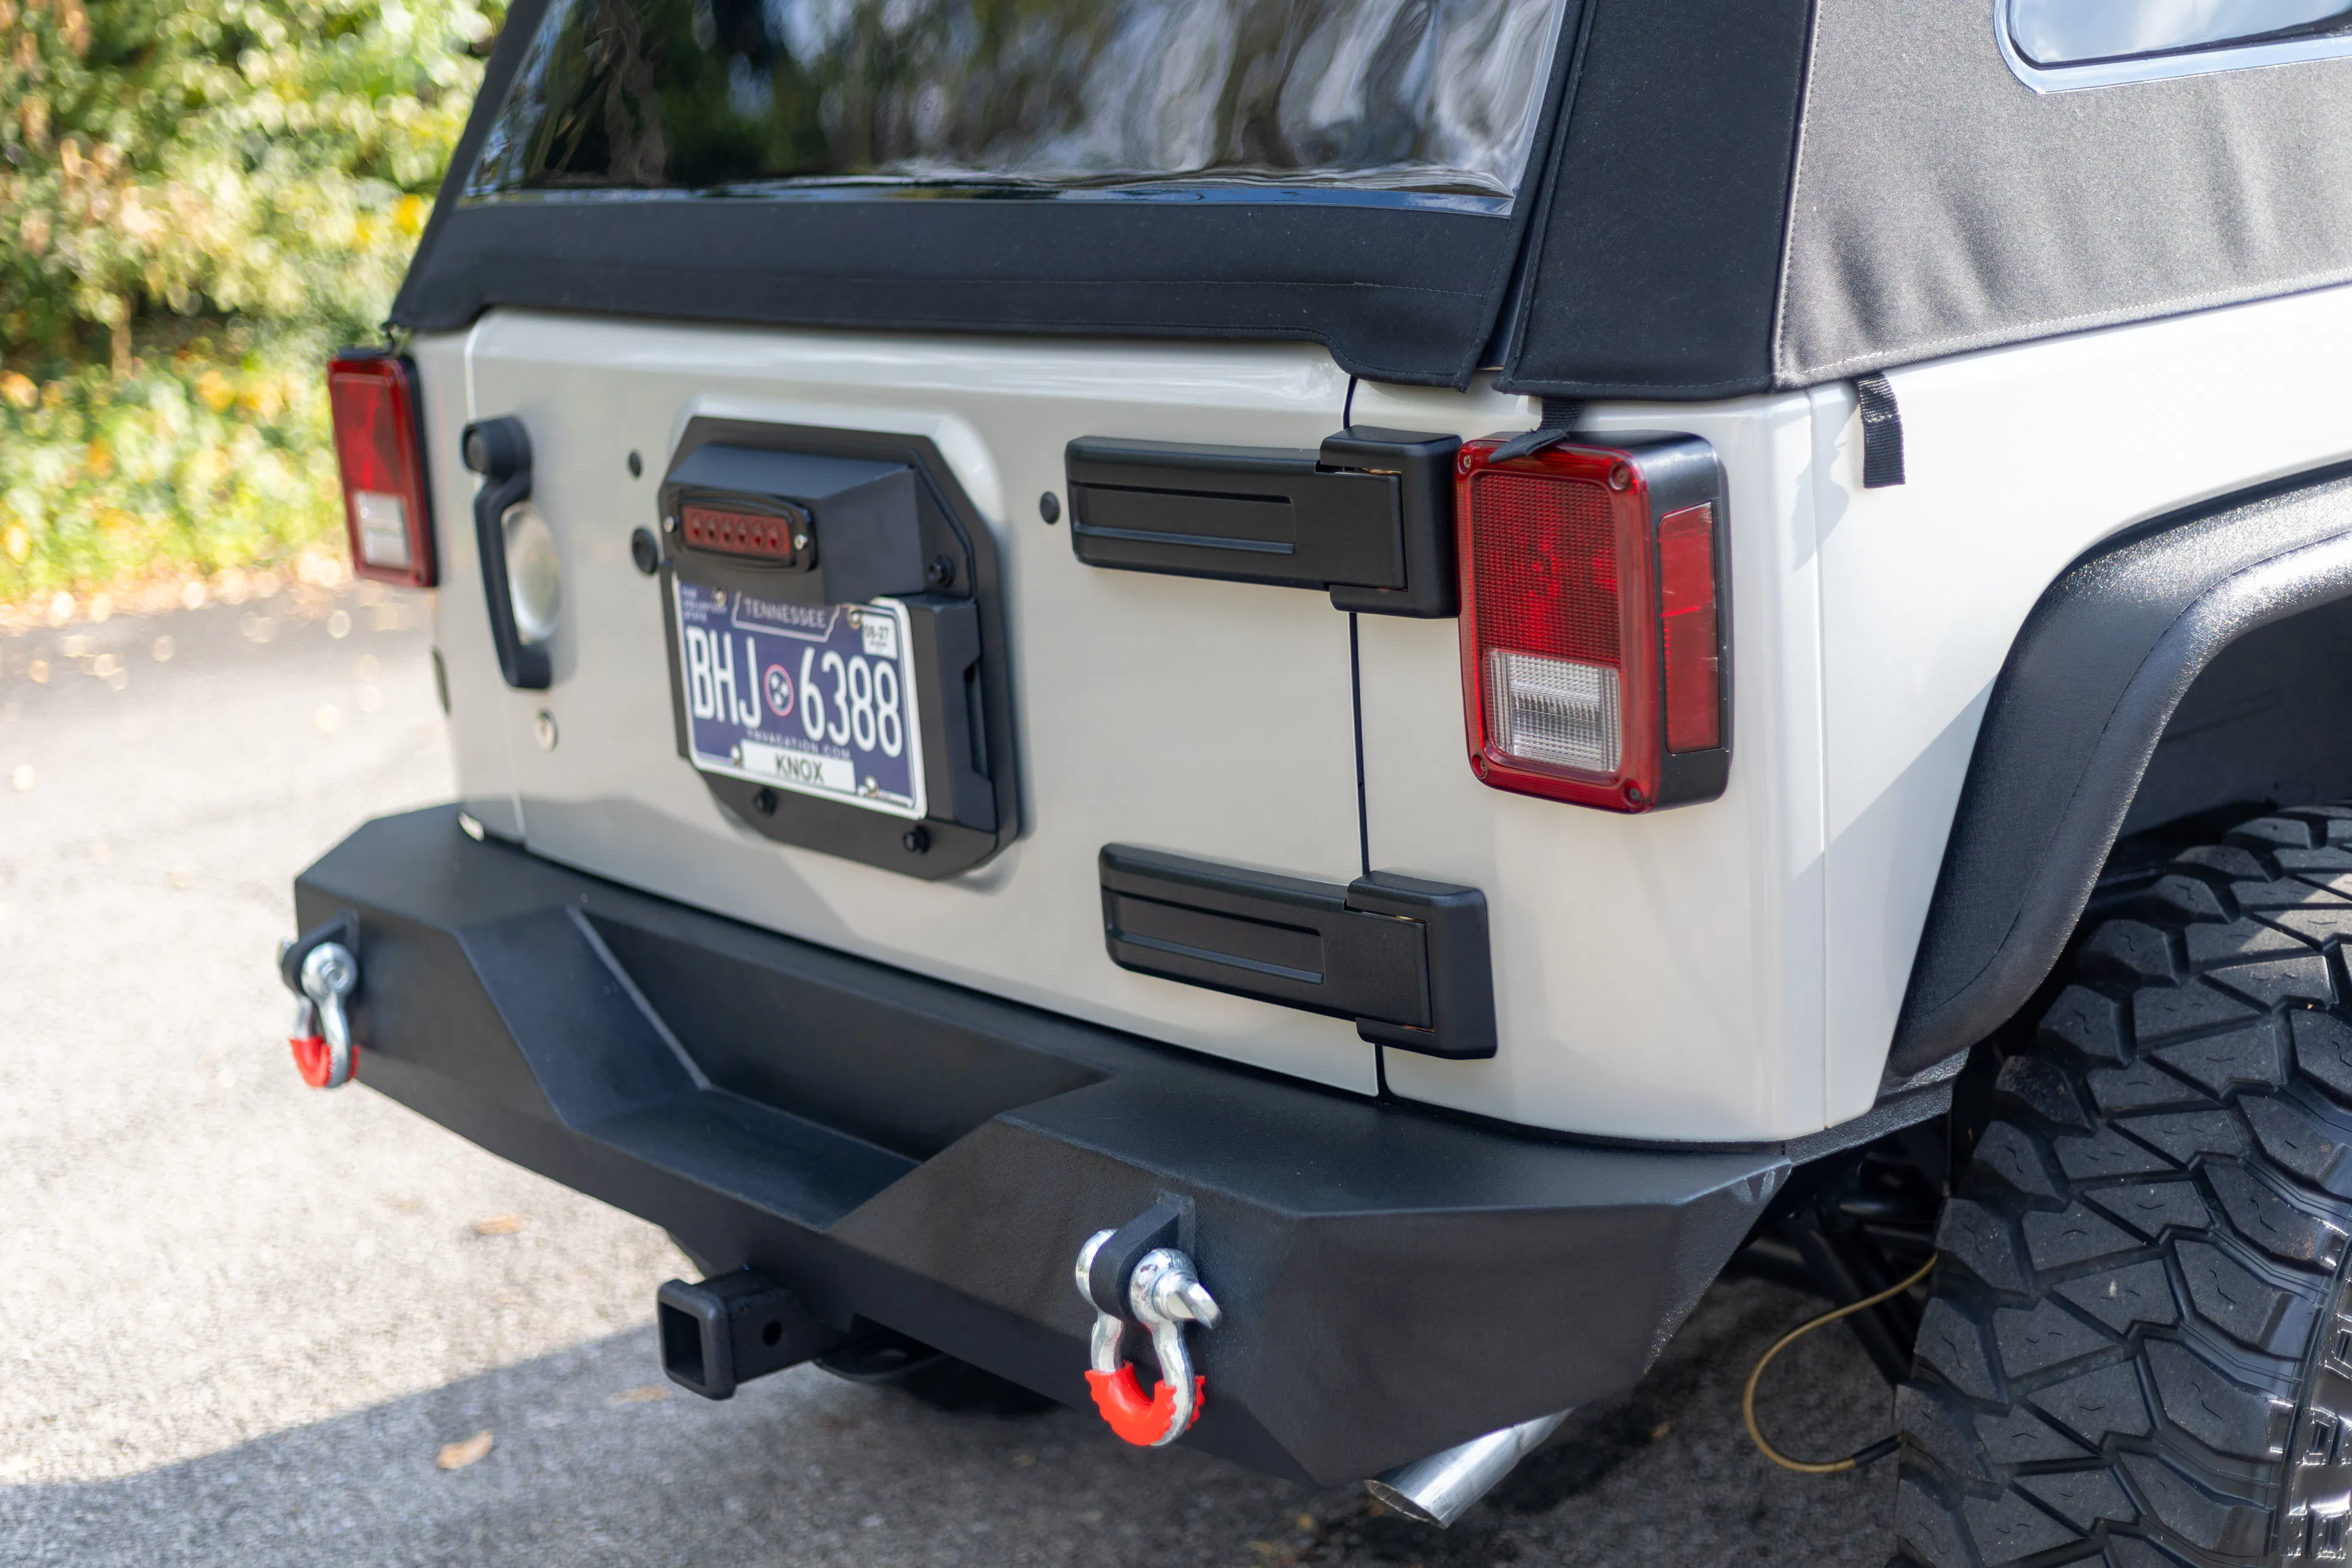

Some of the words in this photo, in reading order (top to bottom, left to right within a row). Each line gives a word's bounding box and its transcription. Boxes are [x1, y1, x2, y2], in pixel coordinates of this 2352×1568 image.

[742, 597, 827, 629] TENNESSEE
[686, 625, 762, 729] BHJ
[799, 646, 903, 758] 6388
[775, 753, 824, 782] KNOX
